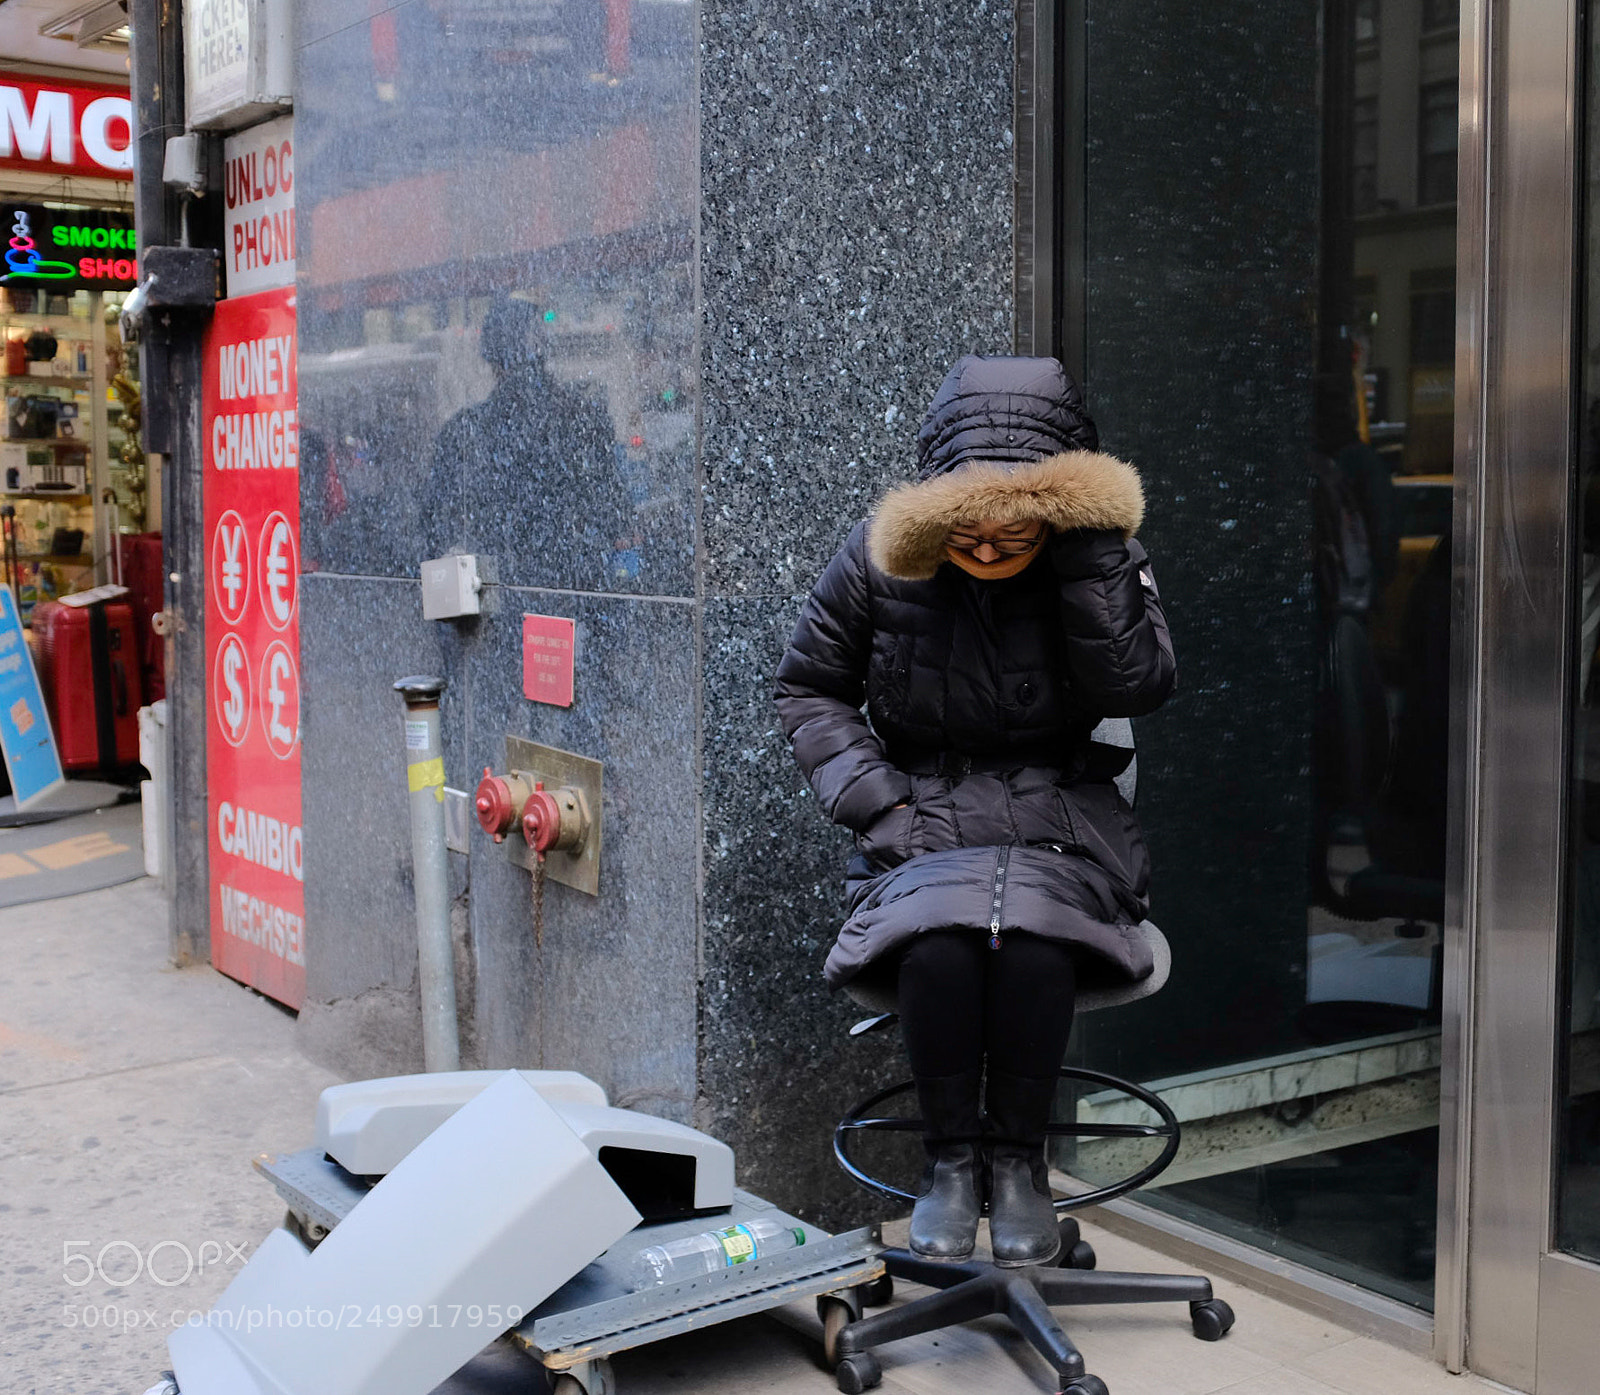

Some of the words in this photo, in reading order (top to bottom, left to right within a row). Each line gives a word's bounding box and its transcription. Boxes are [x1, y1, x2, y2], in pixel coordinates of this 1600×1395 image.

[225, 139, 293, 210] UNLOC
[52, 225, 137, 250] SMOKE
[219, 335, 291, 400] MONEY
[212, 410, 297, 470] CHANGE
[218, 801, 304, 882] CAMBIO
